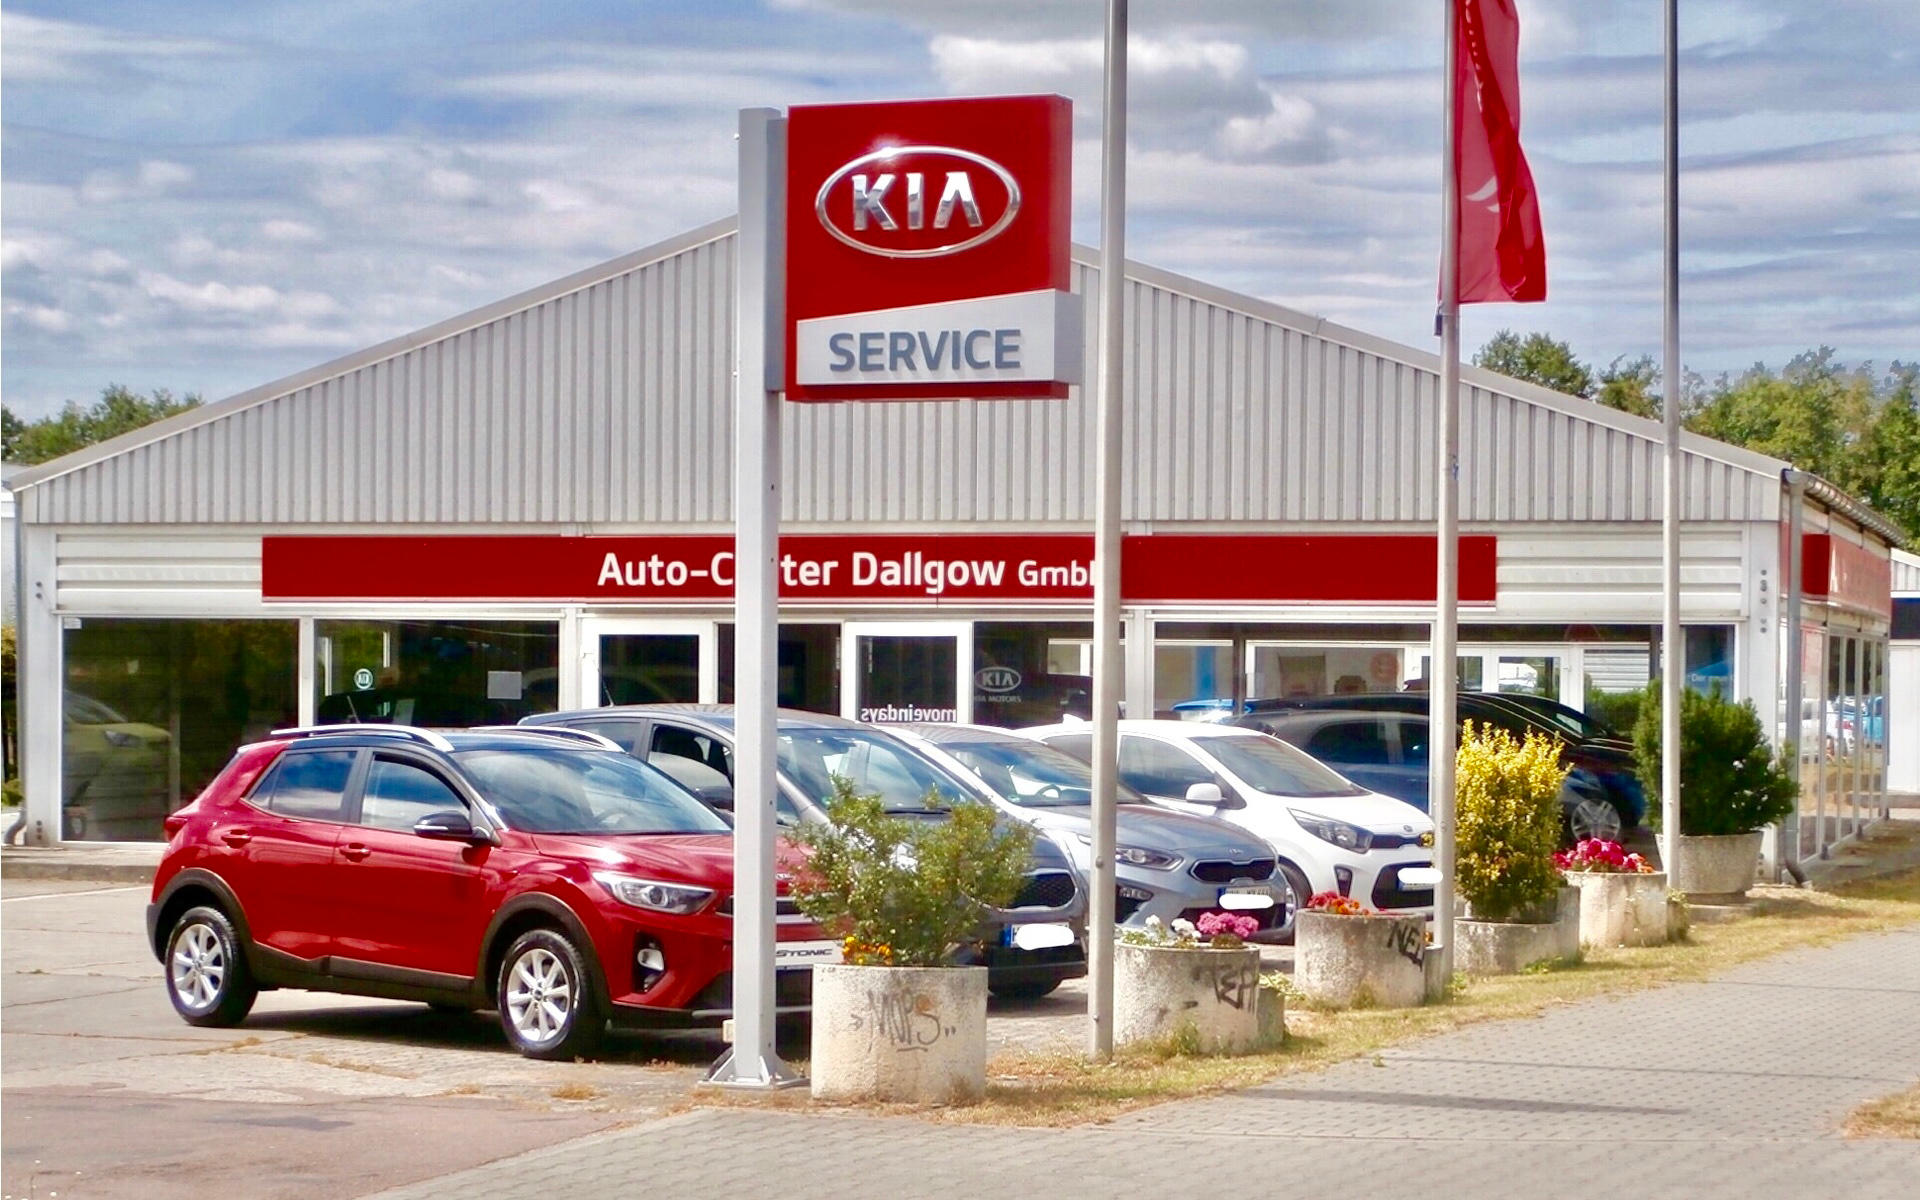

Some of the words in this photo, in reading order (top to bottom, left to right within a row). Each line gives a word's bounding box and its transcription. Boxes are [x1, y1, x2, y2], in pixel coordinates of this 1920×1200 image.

[852, 171, 982, 231] KIA
[828, 328, 1022, 372] SERVICE
[597, 552, 839, 586] Auto-Cter
[852, 551, 1006, 594] Dallgow
[982, 672, 1014, 687] KIA
[775, 948, 833, 957] STONIC
